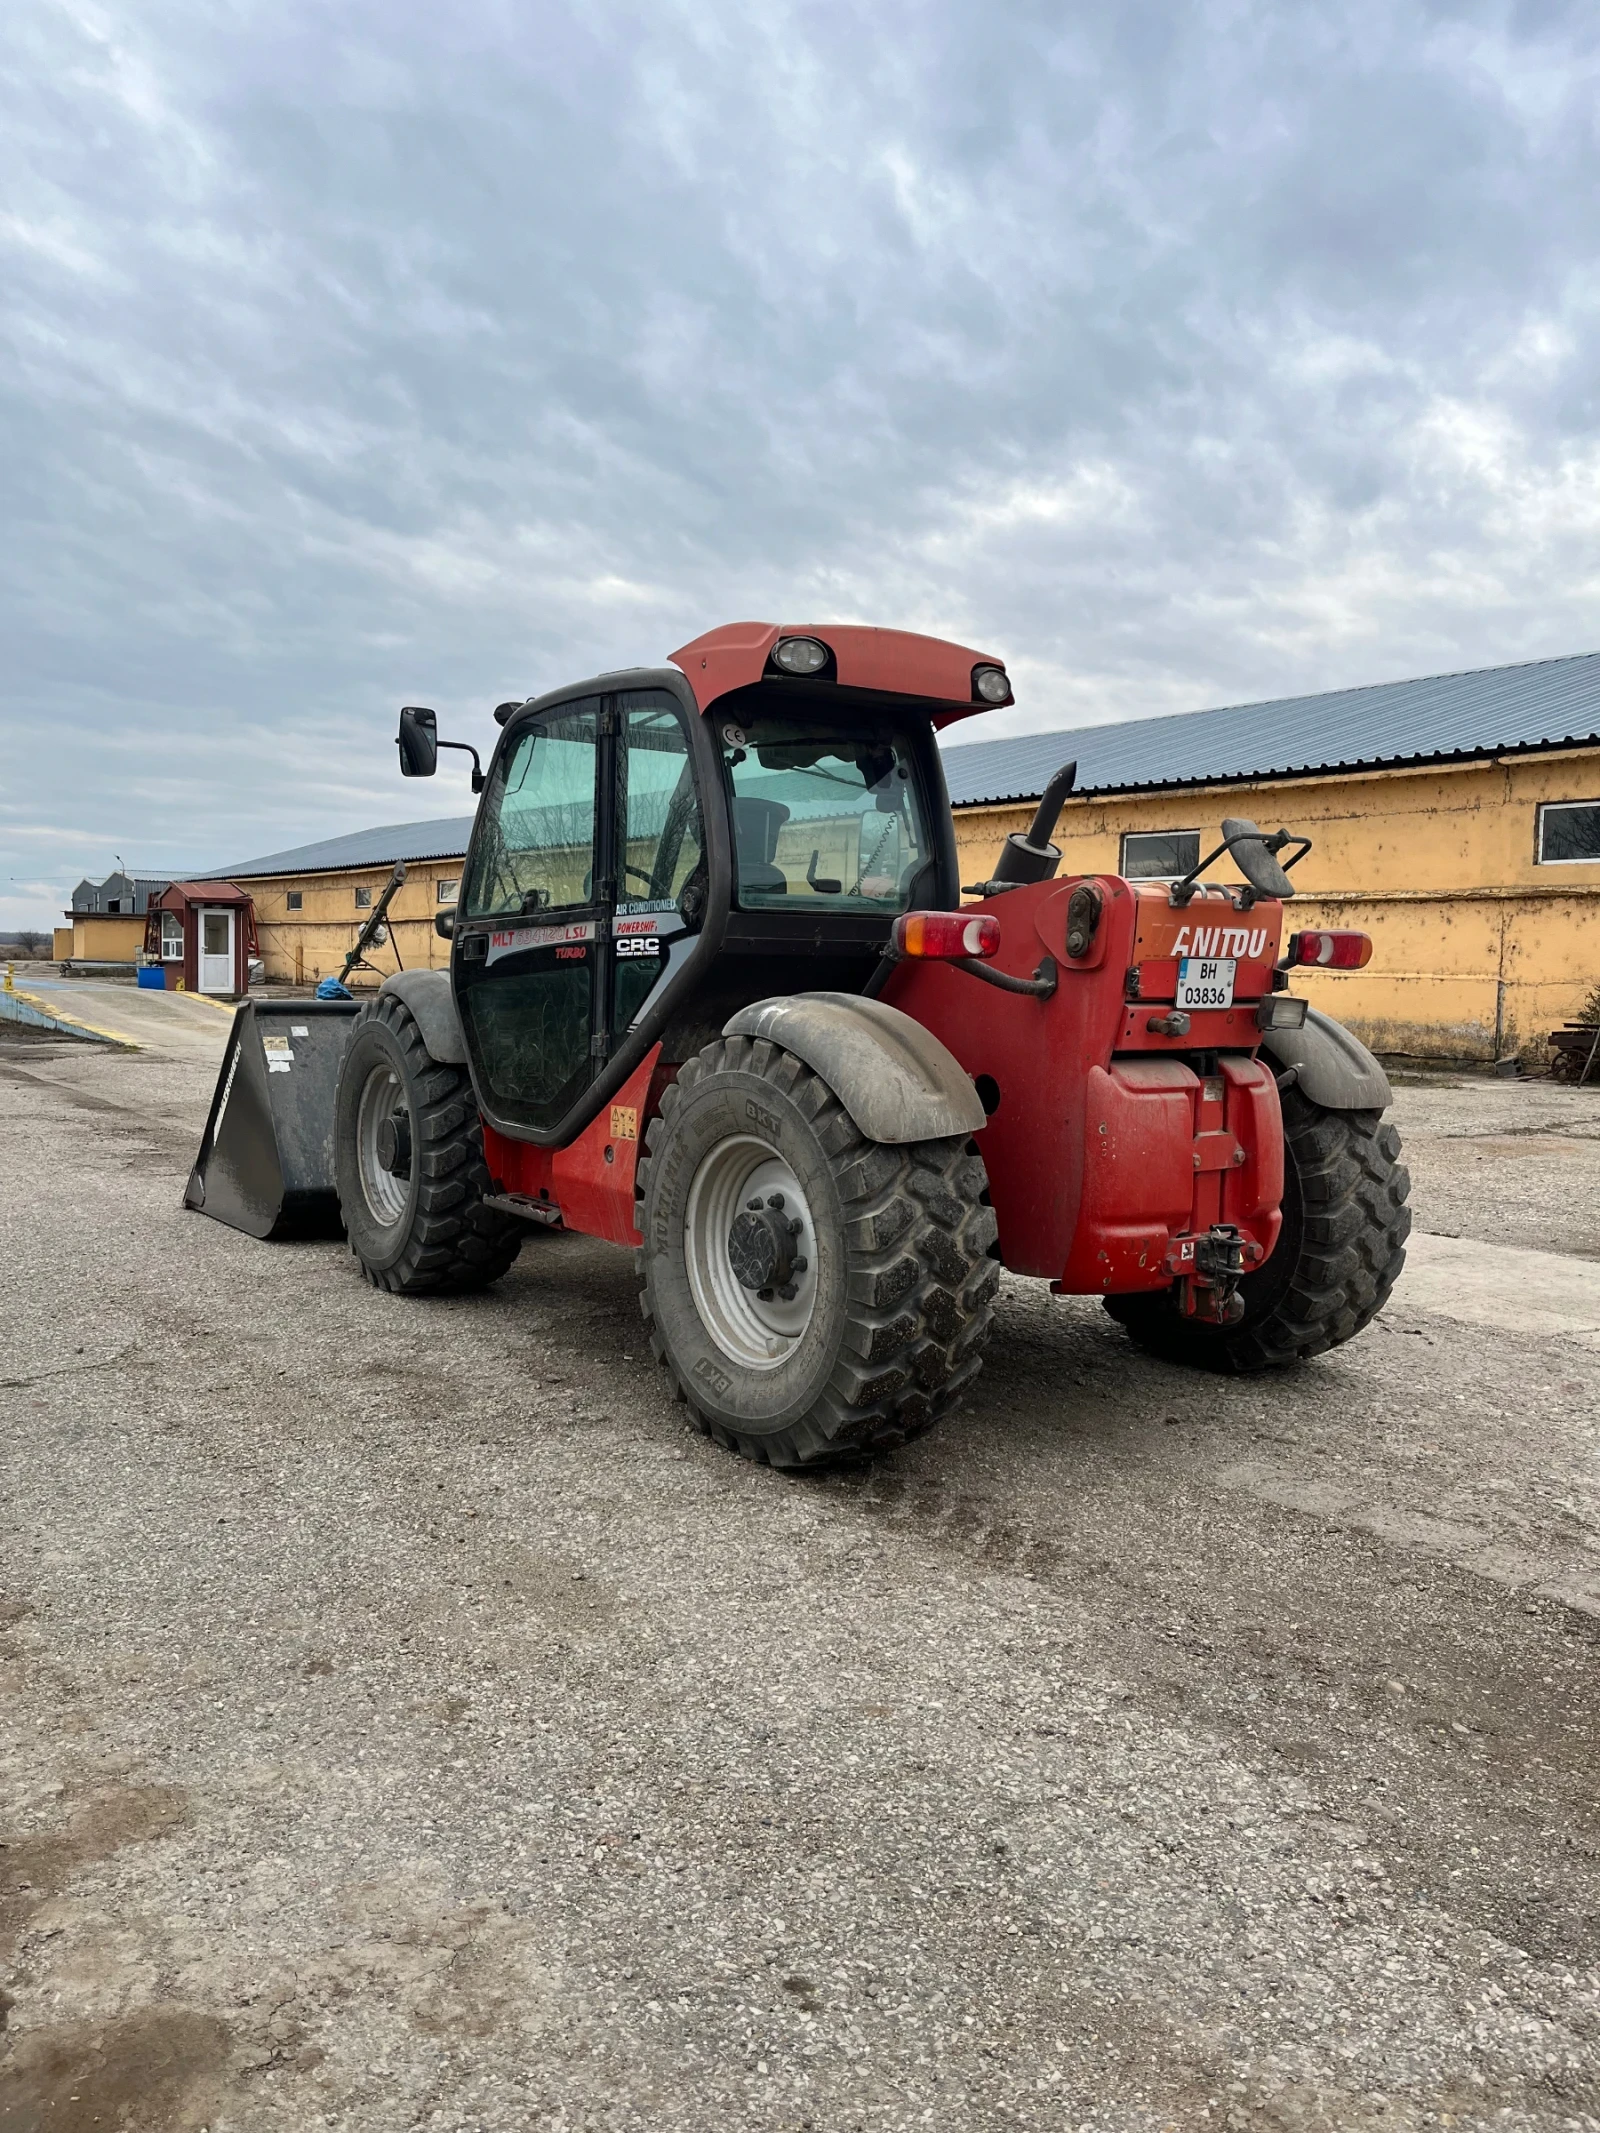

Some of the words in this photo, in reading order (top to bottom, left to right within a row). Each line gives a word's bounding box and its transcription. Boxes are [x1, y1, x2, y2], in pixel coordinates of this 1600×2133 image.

[725, 729, 743, 743] CE
[616, 904, 628, 915] AIR
[629, 899, 676, 914] CONDITIONED
[492, 931, 515, 947] MLT
[565, 926, 588, 940] LSU
[616, 938, 660, 951] CRC
[1146, 923, 1268, 958] ANITOU
[555, 946, 587, 959] TURBO
[1200, 963, 1217, 979] BH
[1185, 987, 1225, 1004] 03836
[746, 1099, 782, 1137] BKT
[693, 1359, 731, 1393] BKT
